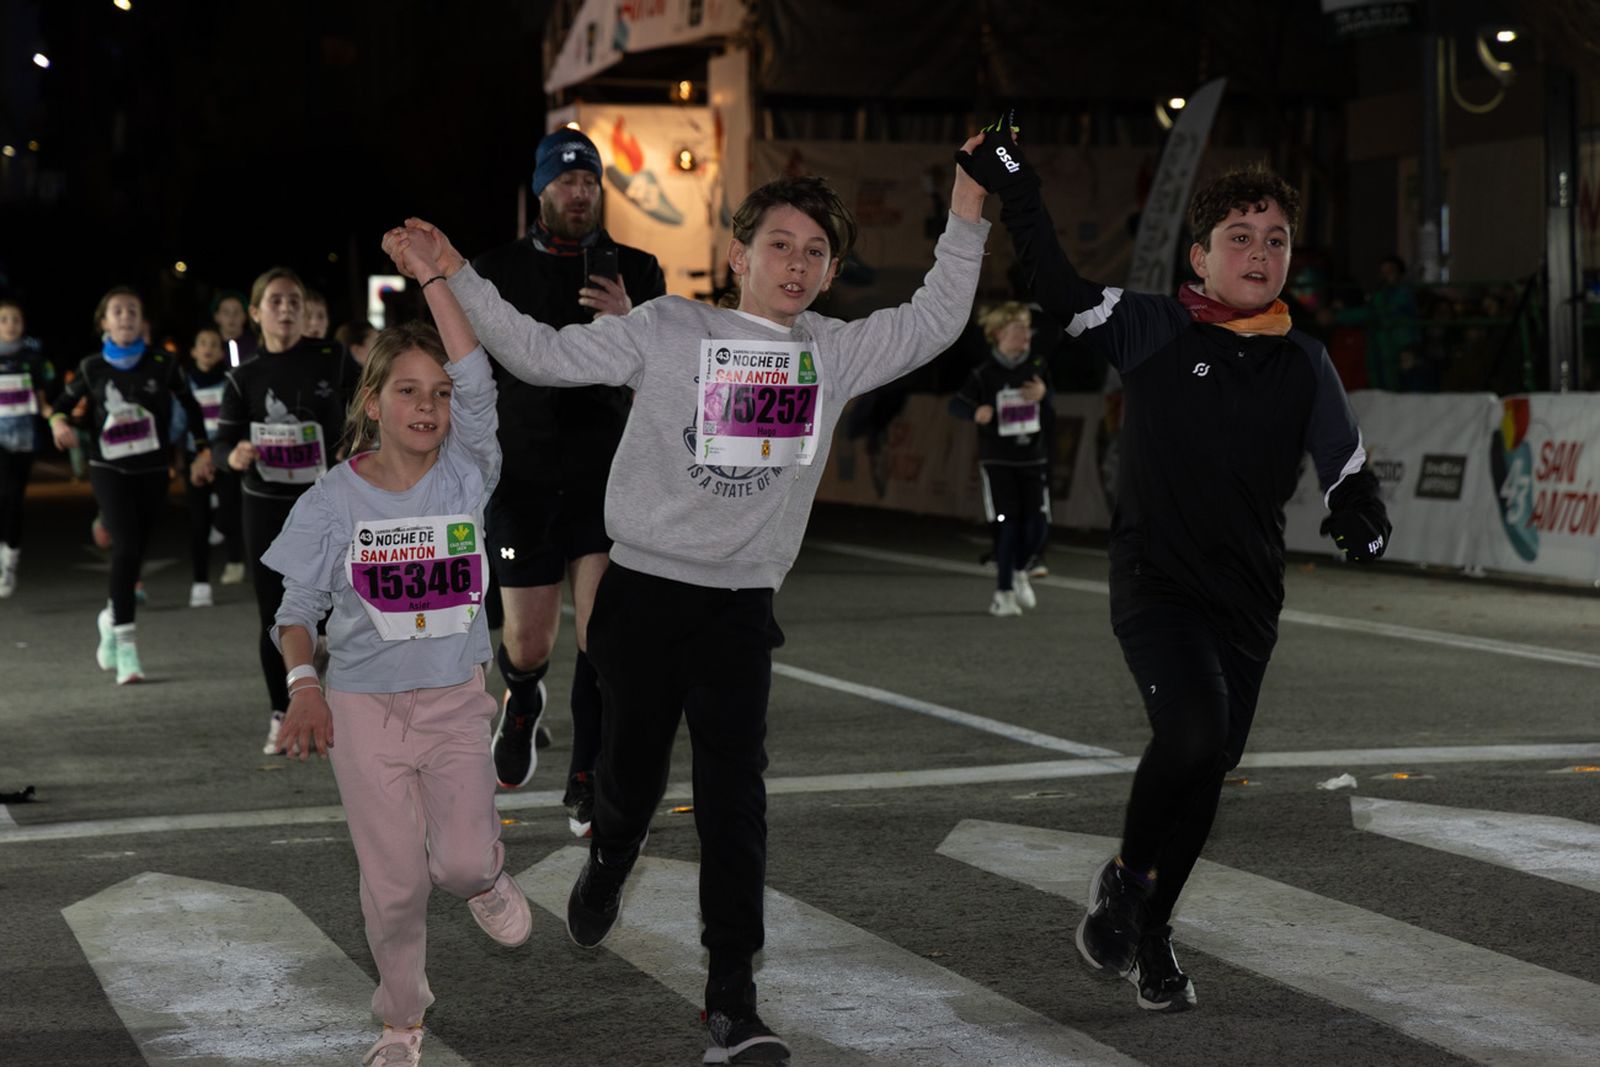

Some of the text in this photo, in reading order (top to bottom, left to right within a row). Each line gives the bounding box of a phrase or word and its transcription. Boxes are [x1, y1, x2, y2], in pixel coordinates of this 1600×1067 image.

[995, 146, 1020, 173] ipso
[717, 351, 730, 362] 43
[732, 355, 790, 369] NOCHE DE
[715, 369, 744, 383] SAN
[745, 369, 789, 384] ANTÓN
[721, 387, 812, 424] 15252
[757, 427, 777, 437] Hugo
[1537, 441, 1584, 484] SAN
[687, 464, 704, 479] IS
[699, 476, 712, 489] A
[712, 481, 753, 498] STATE
[757, 475, 771, 491] OF
[1526, 480, 1600, 536] ANTÓN
[375, 531, 435, 546] NOCHE DE
[361, 550, 388, 562] SAN
[390, 544, 435, 561] ANTÓN
[362, 558, 471, 600] 15346
[409, 601, 430, 610] Asier
